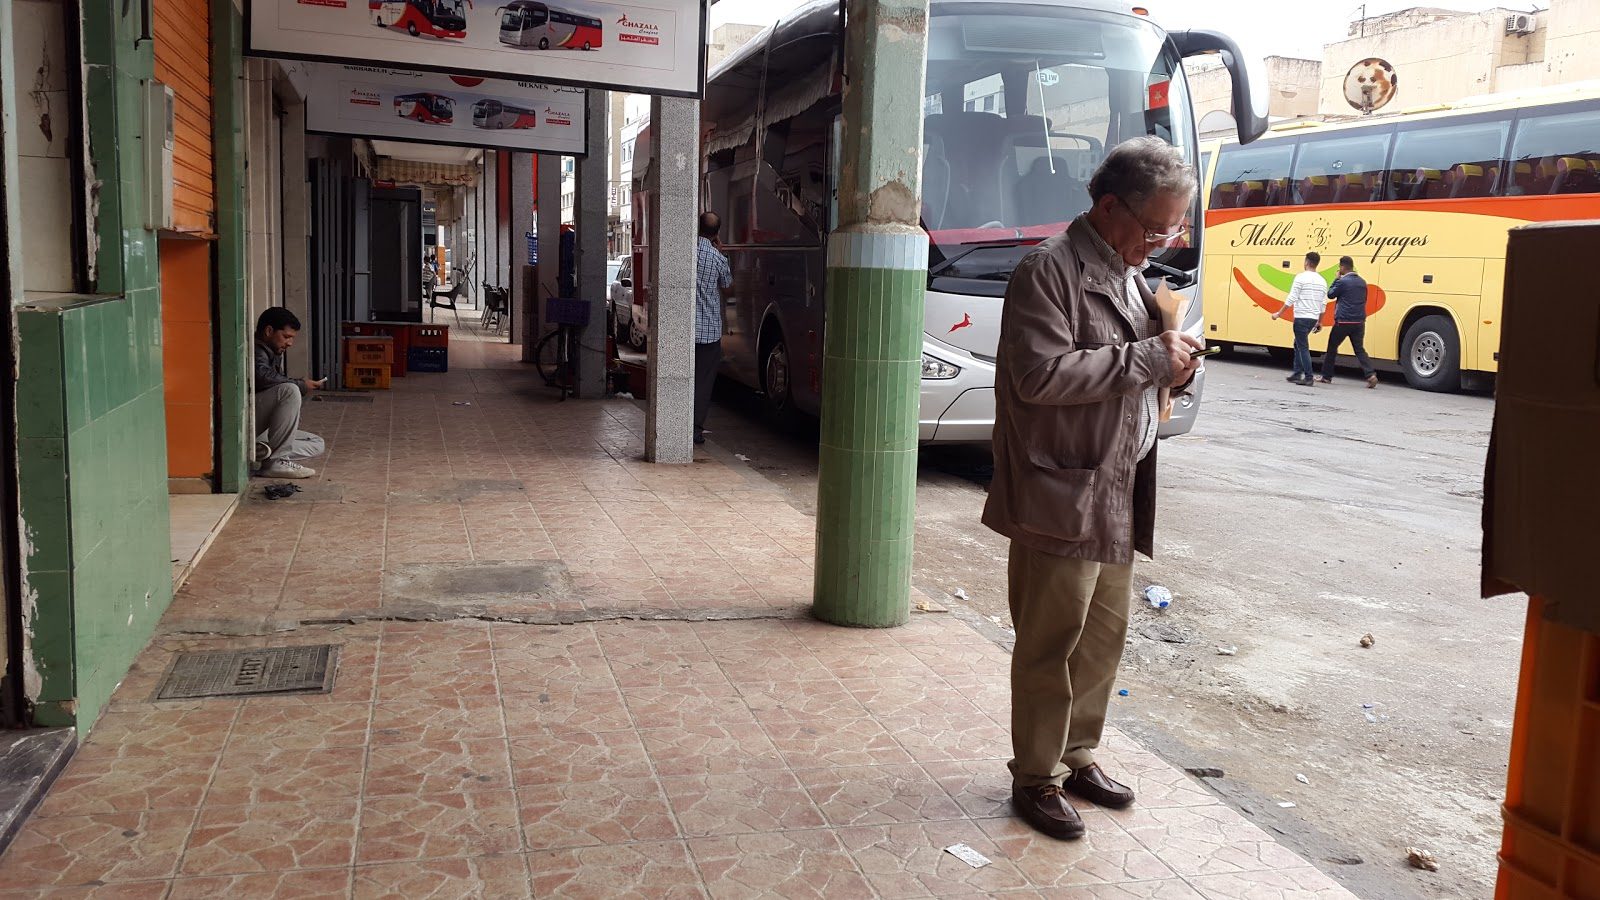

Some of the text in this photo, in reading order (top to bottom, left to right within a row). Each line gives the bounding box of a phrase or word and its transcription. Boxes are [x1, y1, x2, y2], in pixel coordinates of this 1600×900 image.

[622, 20, 658, 30] GHAZALA
[517, 81, 549, 90] MEKNES
[1230, 219, 1430, 264] Mekka Voyages
